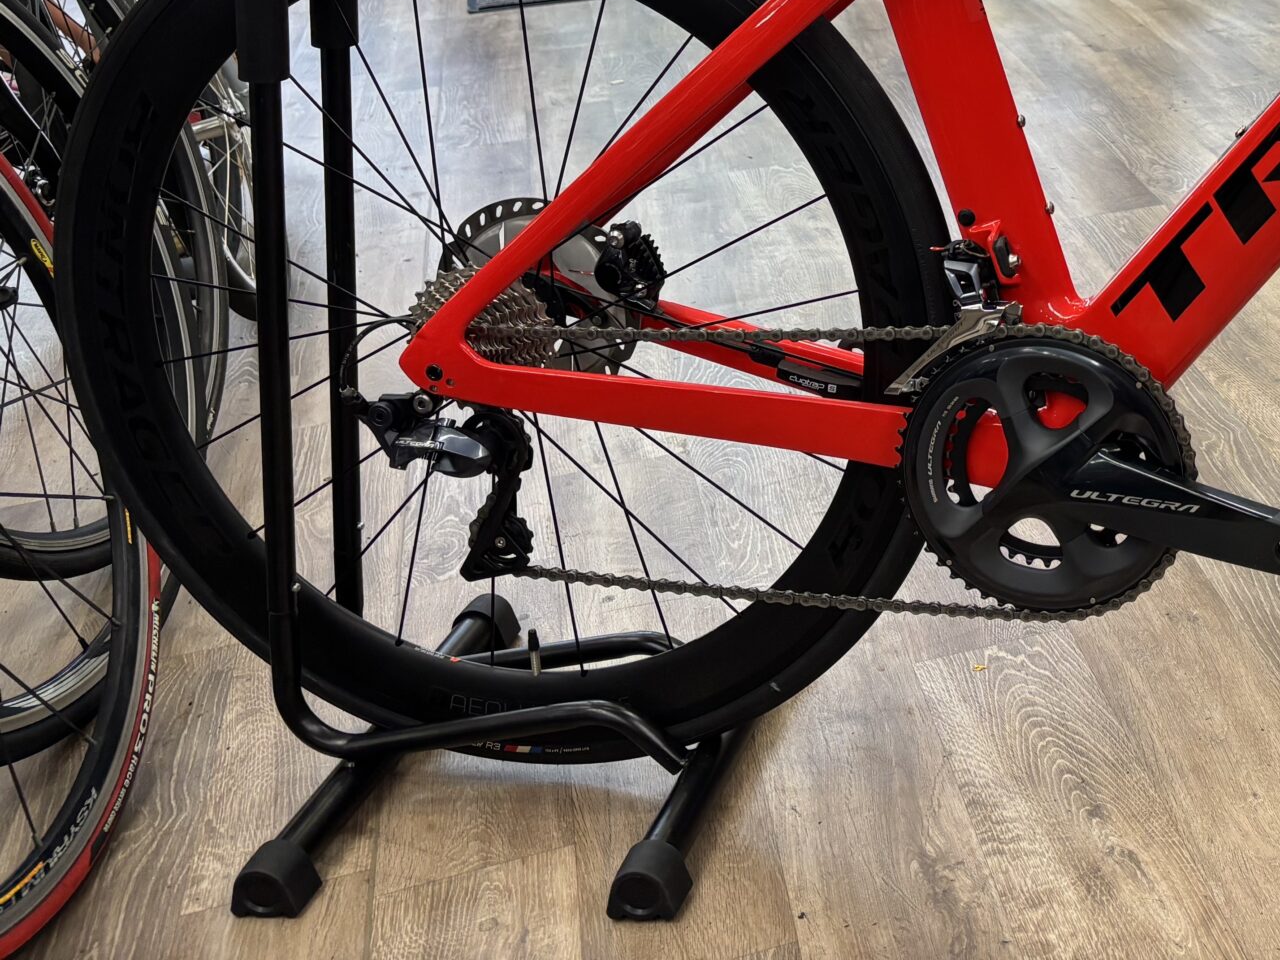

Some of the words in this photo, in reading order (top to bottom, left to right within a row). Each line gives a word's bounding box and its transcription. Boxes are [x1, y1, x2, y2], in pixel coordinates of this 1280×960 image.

[927, 419, 942, 476] ULTEGRA
[1070, 489, 1201, 513] ULTEGRA
[149, 610, 160, 674] MICHELIN
[485, 741, 501, 751] R3
